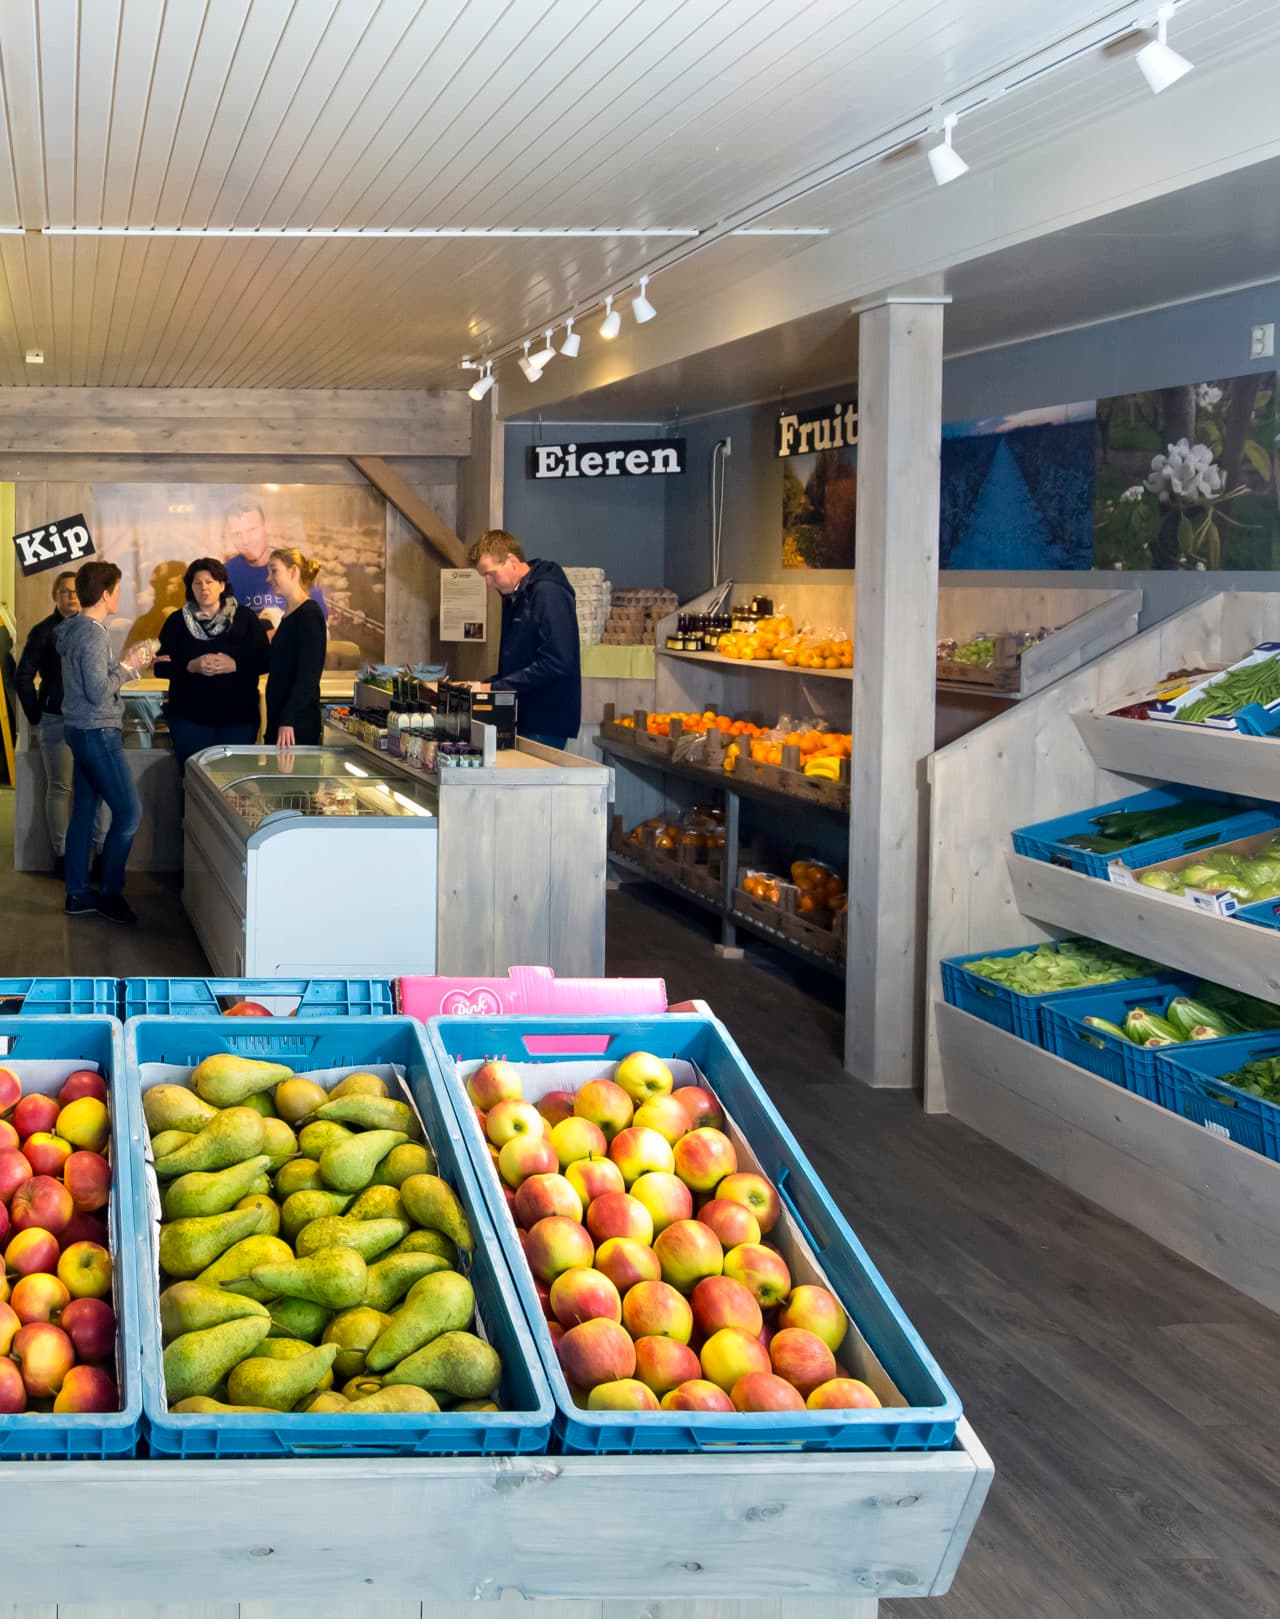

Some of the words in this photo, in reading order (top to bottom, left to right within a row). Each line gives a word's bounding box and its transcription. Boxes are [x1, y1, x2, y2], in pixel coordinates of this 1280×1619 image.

[778, 403, 859, 457] Fruit
[535, 443, 681, 478] Eieren
[15, 525, 89, 566] Kip
